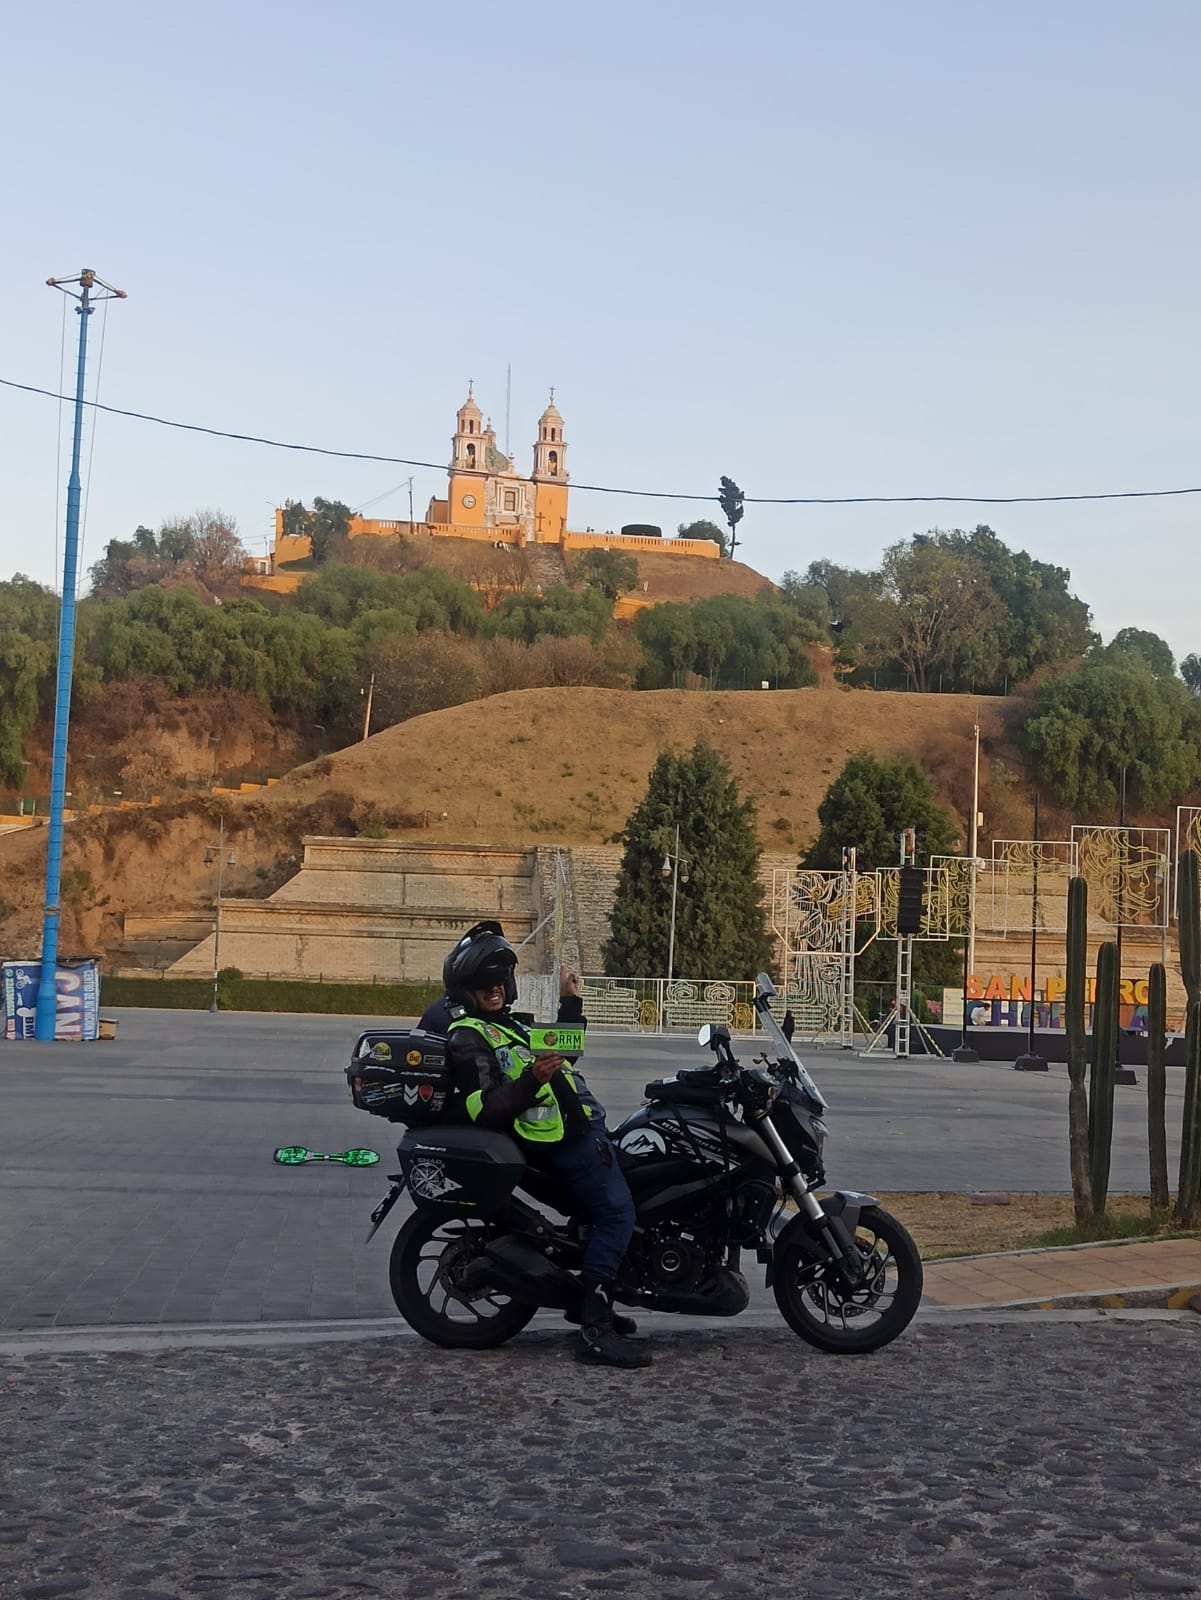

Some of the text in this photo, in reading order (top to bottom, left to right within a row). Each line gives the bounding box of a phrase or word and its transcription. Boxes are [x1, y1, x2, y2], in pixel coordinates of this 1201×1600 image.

[967, 975, 1149, 1005] SAN PRO
[559, 1034, 581, 1045] RRM
